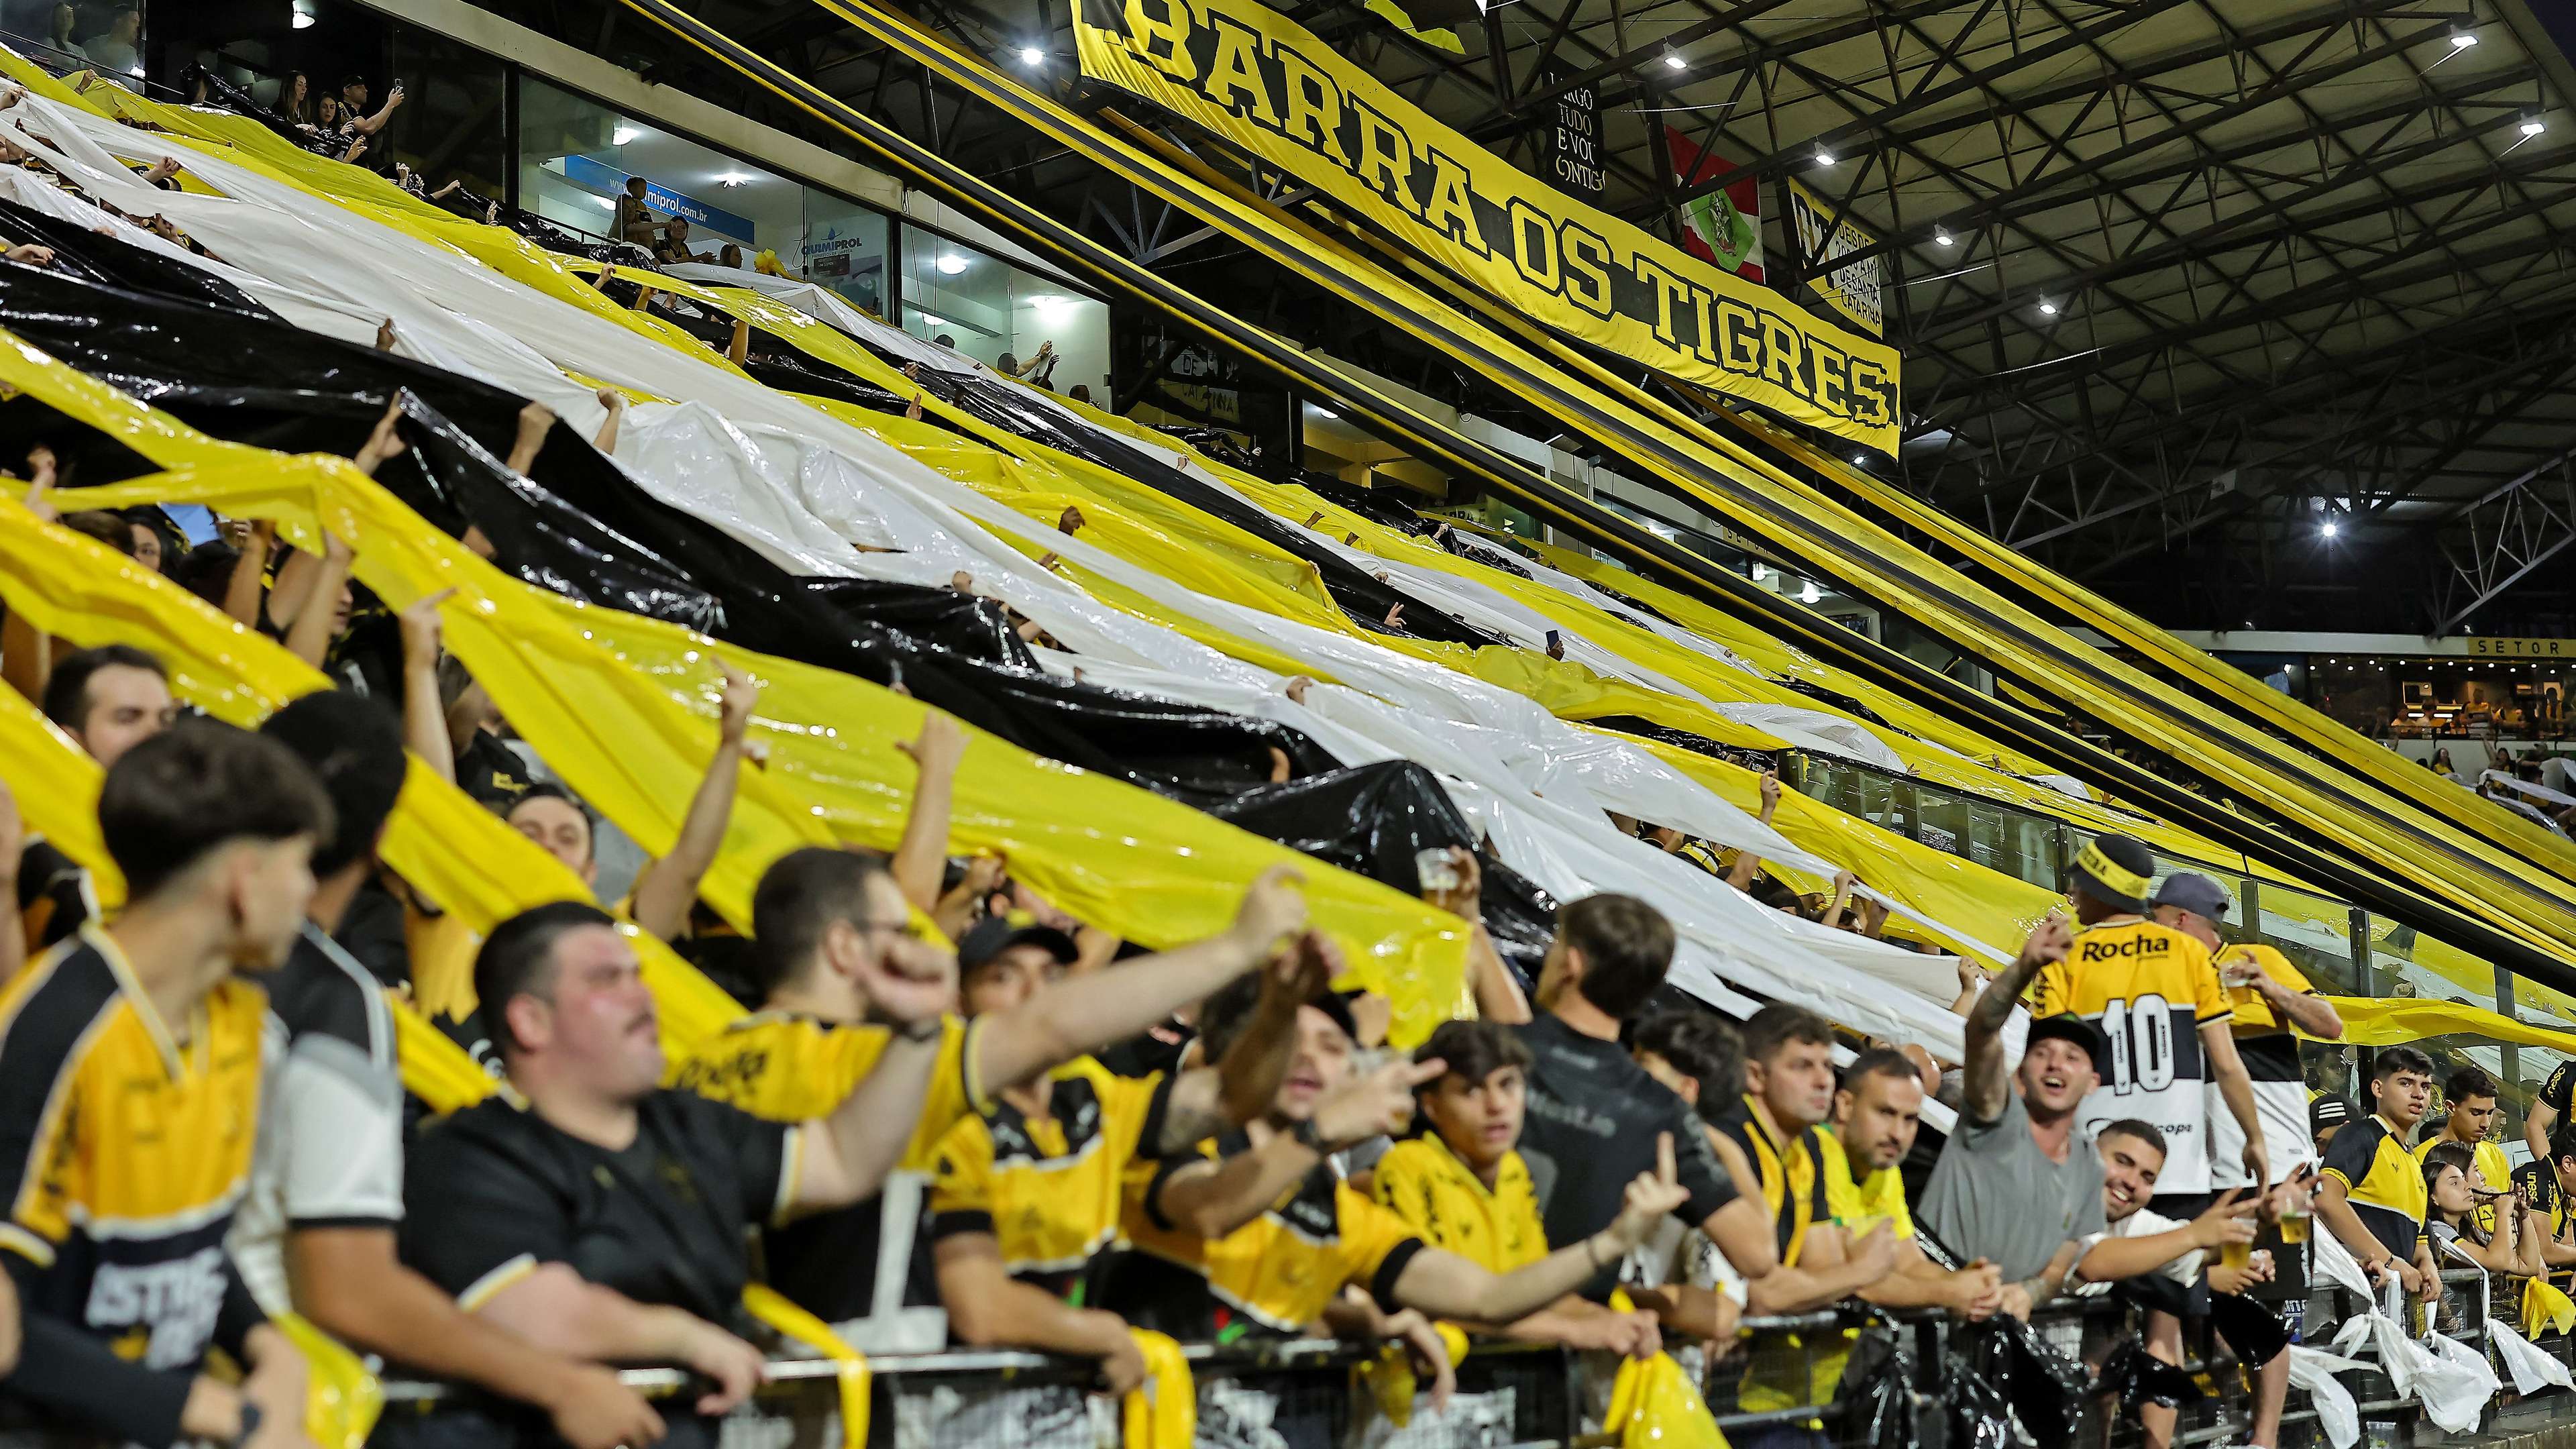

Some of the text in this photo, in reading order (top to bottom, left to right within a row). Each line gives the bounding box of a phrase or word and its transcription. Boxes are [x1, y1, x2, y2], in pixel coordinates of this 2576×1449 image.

[1556, 127, 1568, 150] E
[1123, 0, 1890, 425] BARRA OS TIGRES
[802, 237, 862, 255] QUIMIPROL
[2478, 640, 2559, 655] SETOR
[2082, 934, 2169, 961] Rocha
[2100, 993, 2175, 1096] 10
